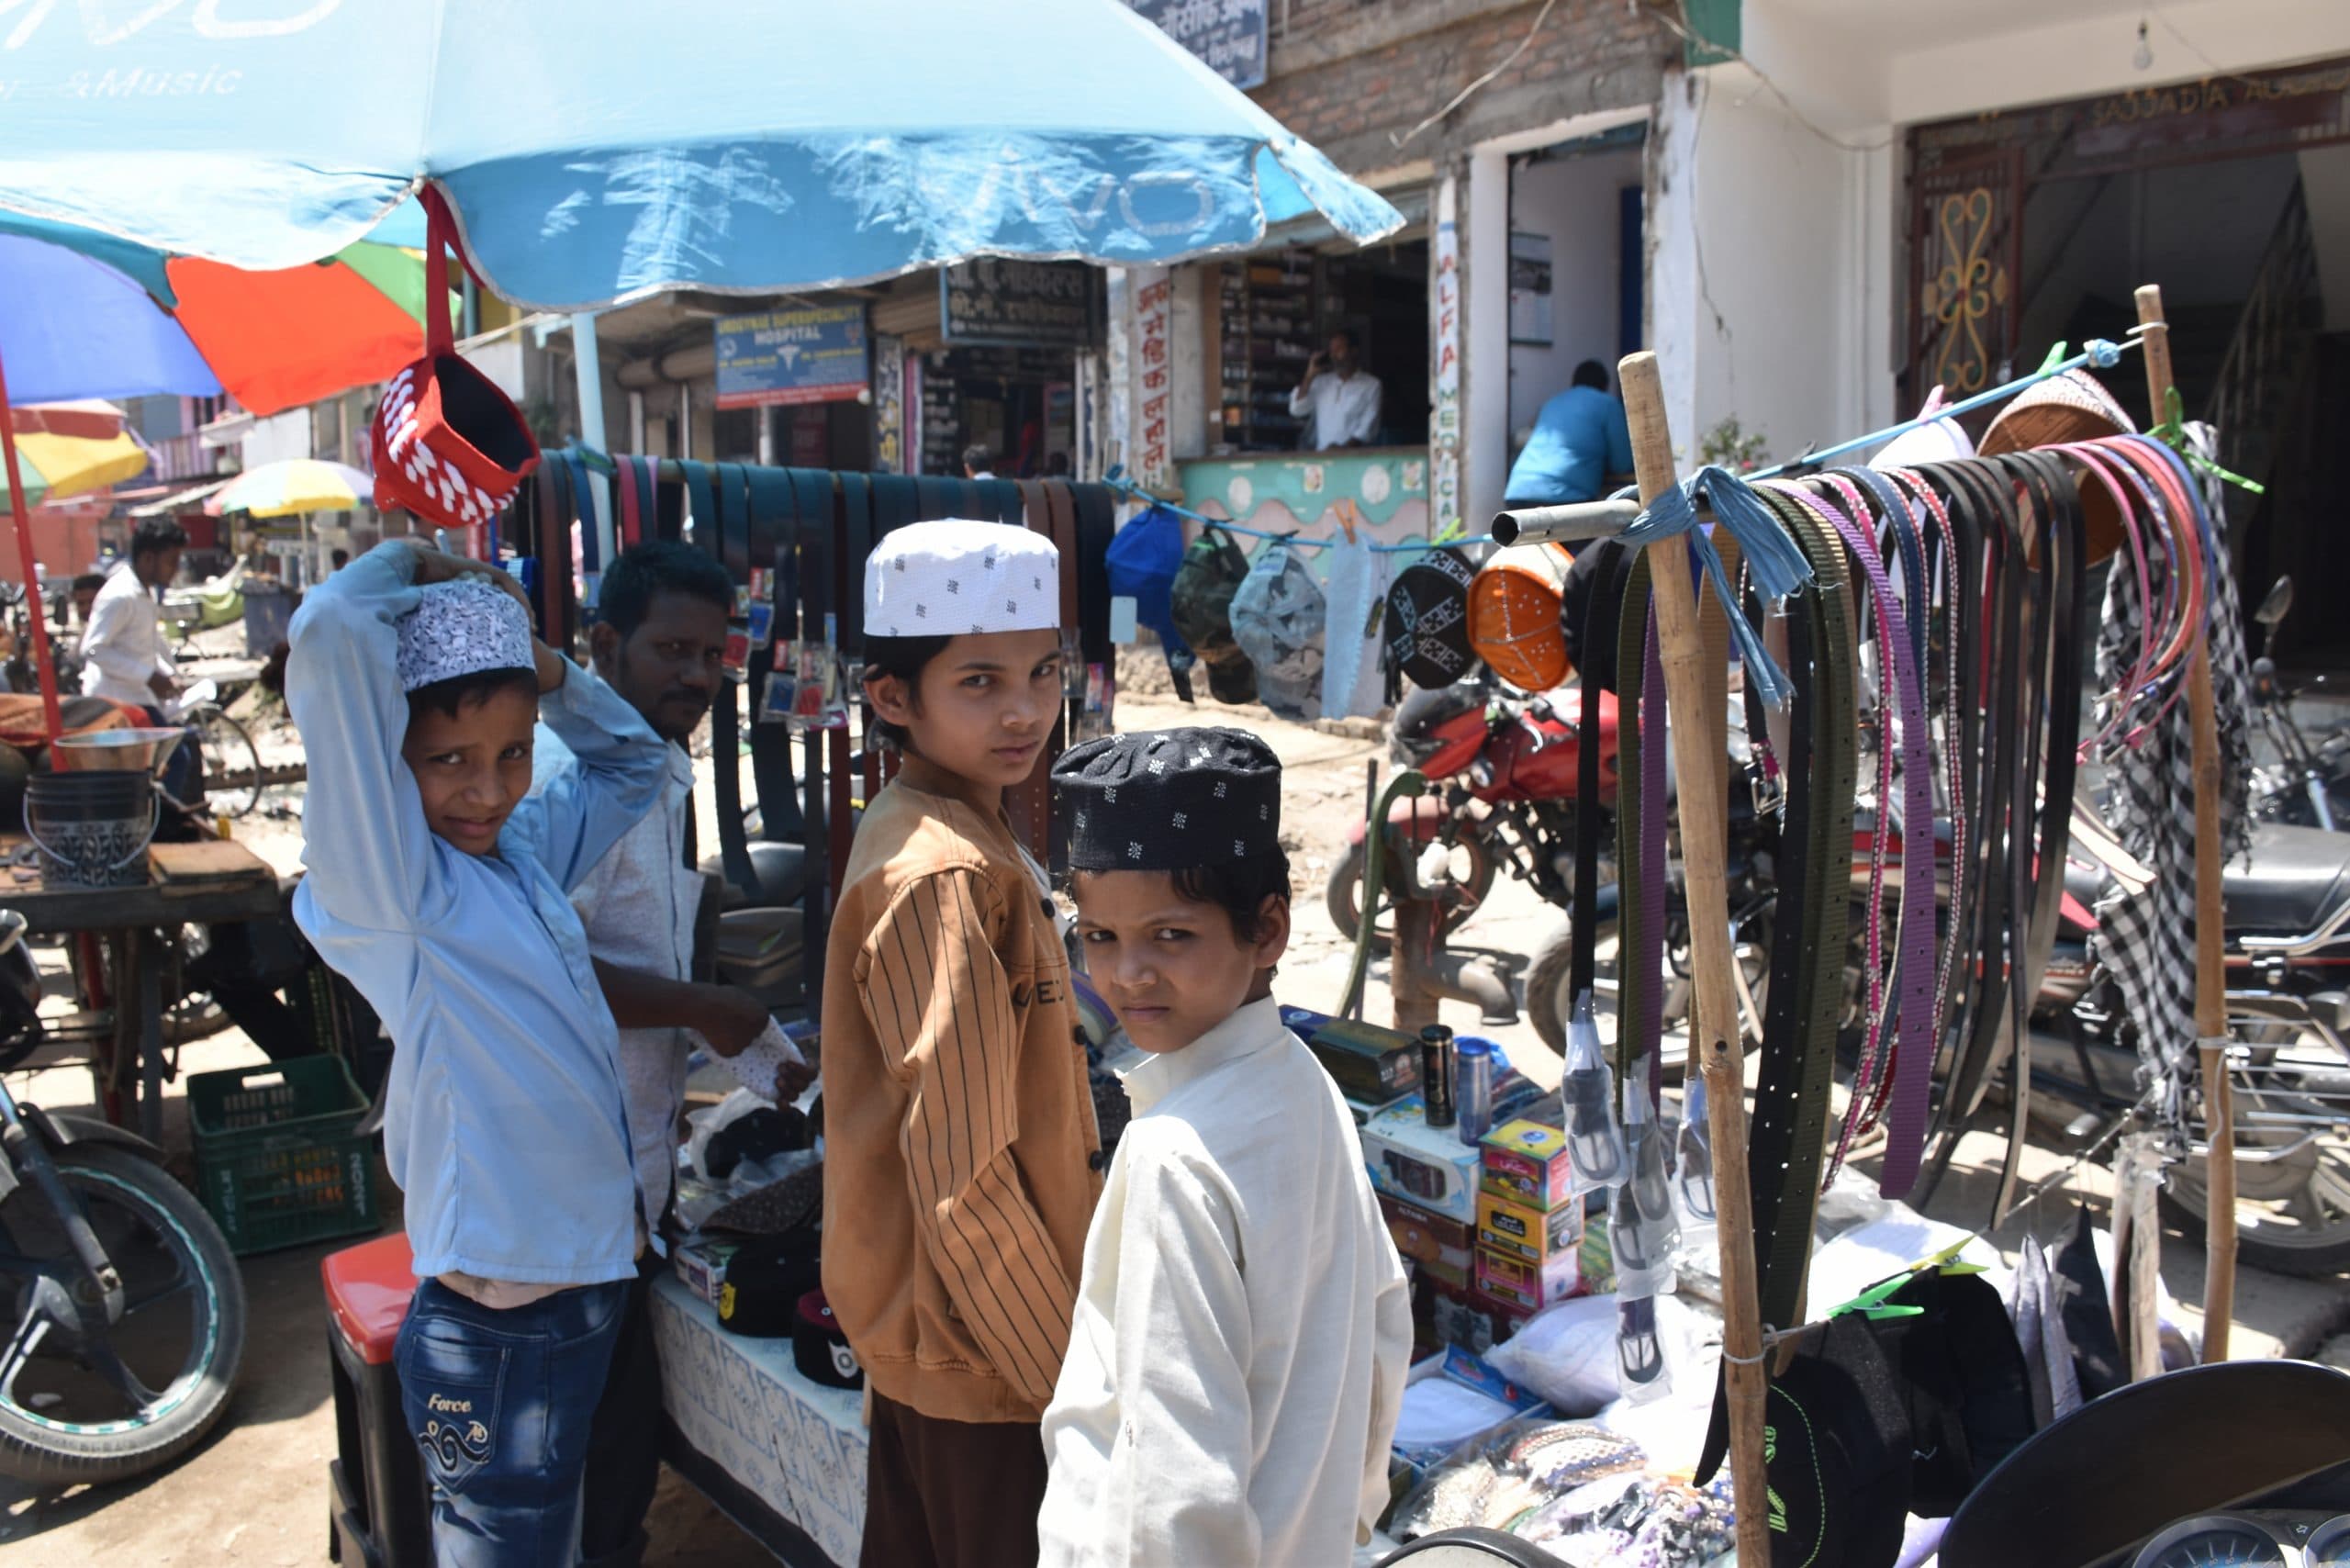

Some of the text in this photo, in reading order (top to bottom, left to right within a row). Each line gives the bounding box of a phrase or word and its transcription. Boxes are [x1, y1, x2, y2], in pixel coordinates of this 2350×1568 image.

[754, 324, 823, 346] HOSPITAL
[1438, 254, 1458, 536] ALFA MEDICA
[427, 1393, 473, 1413] Force
